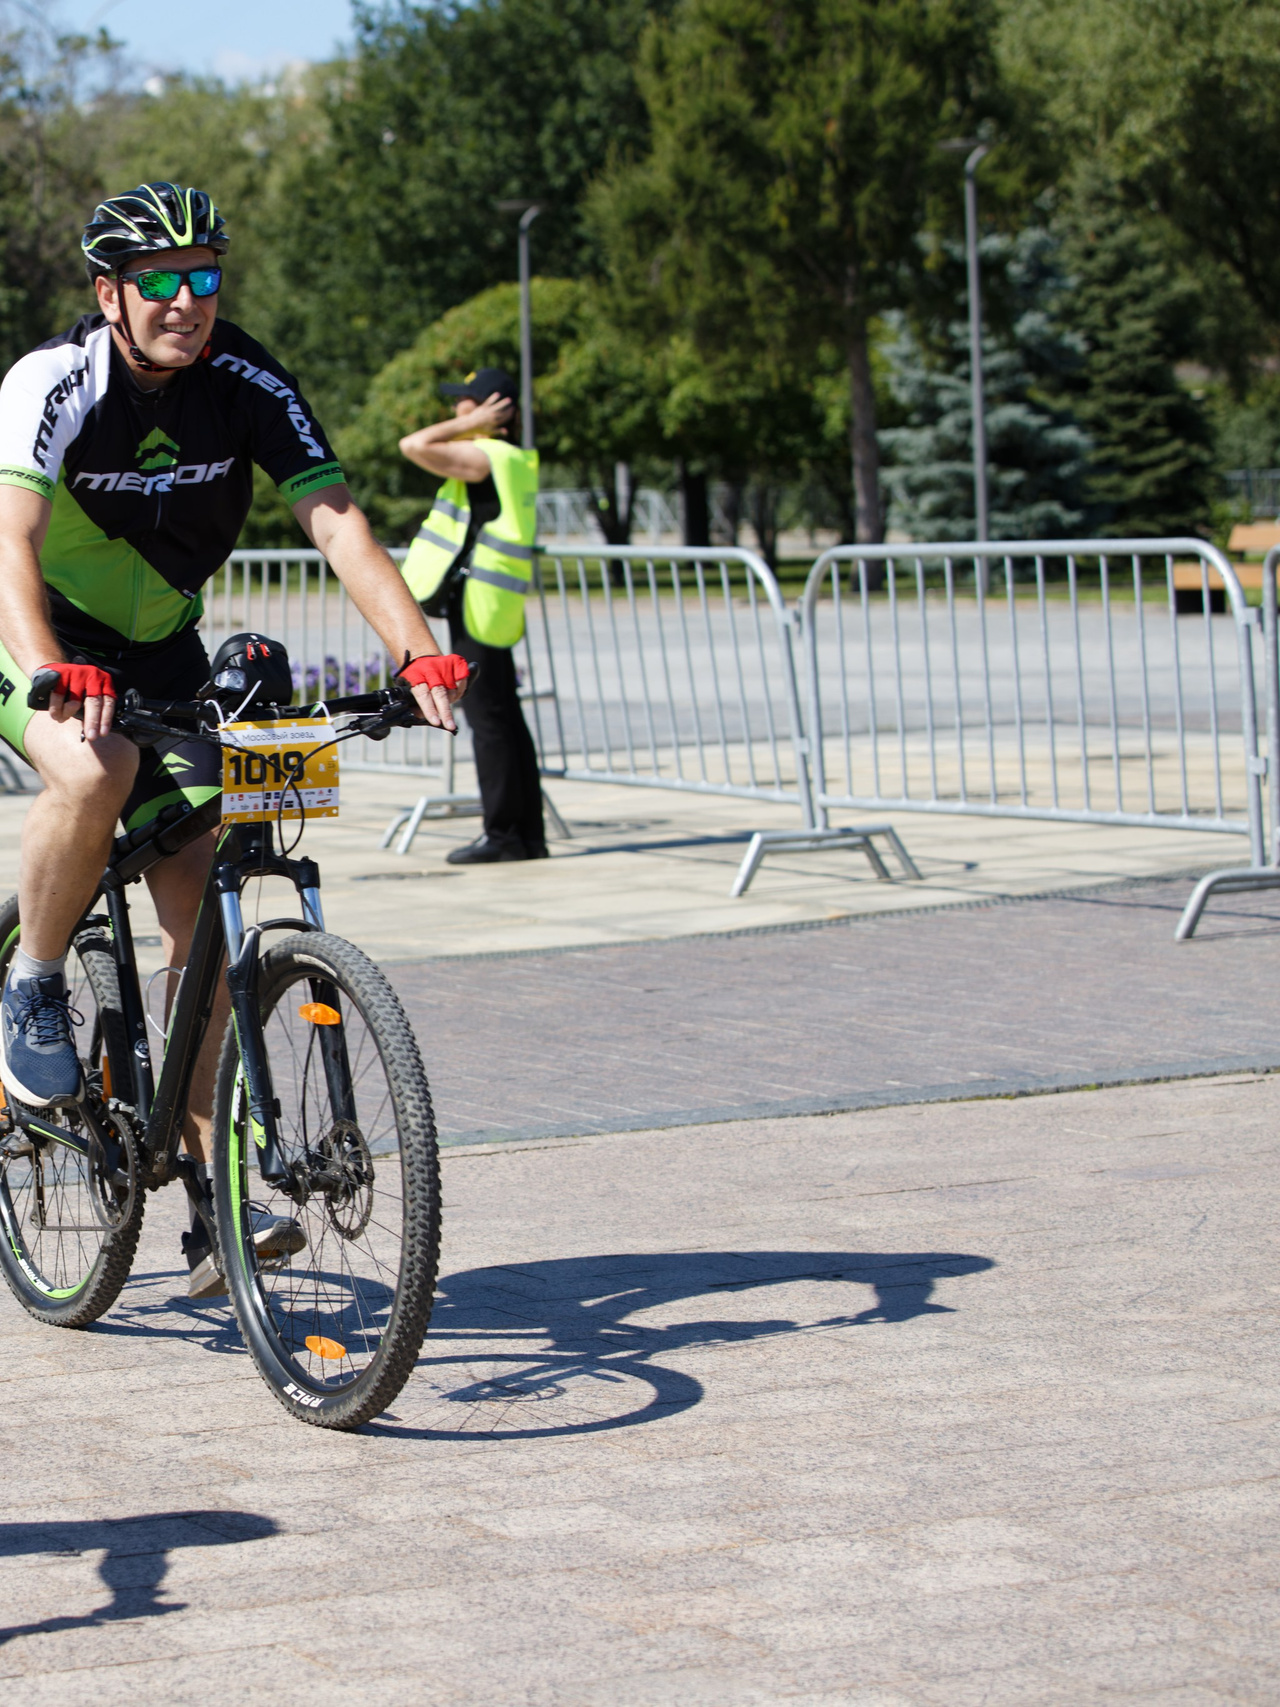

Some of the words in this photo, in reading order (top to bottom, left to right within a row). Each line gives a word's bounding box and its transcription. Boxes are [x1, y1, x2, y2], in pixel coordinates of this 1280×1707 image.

[71, 457, 235, 496] MERDA
[228, 750, 305, 786] 1019
[282, 1382, 325, 1408] RACE
